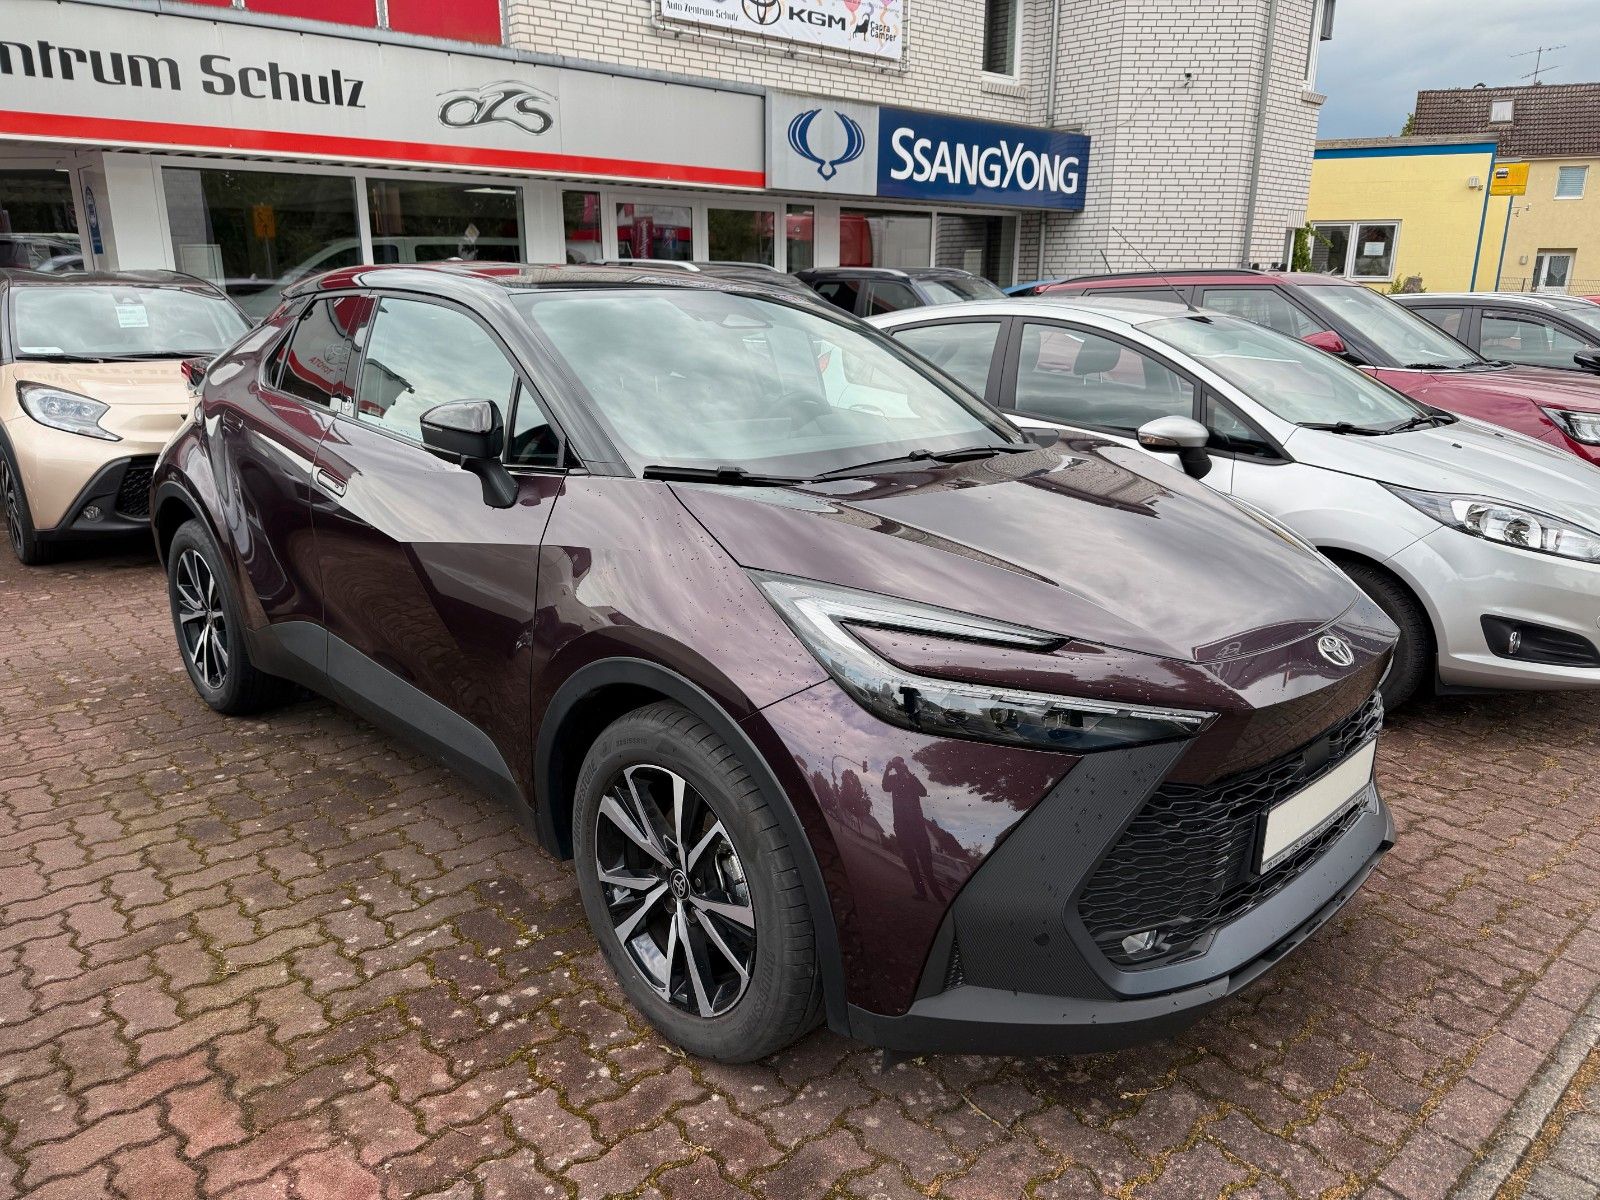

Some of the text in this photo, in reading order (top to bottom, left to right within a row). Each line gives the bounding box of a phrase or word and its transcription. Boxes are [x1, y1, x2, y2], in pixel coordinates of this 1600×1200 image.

[666, 0, 739, 22] Auto Zentrum Schulz
[788, 6, 846, 31] KGM
[870, 20, 891, 33] Capra
[870, 28, 897, 42] Camper
[0, 40, 367, 109] ntrum Schulz
